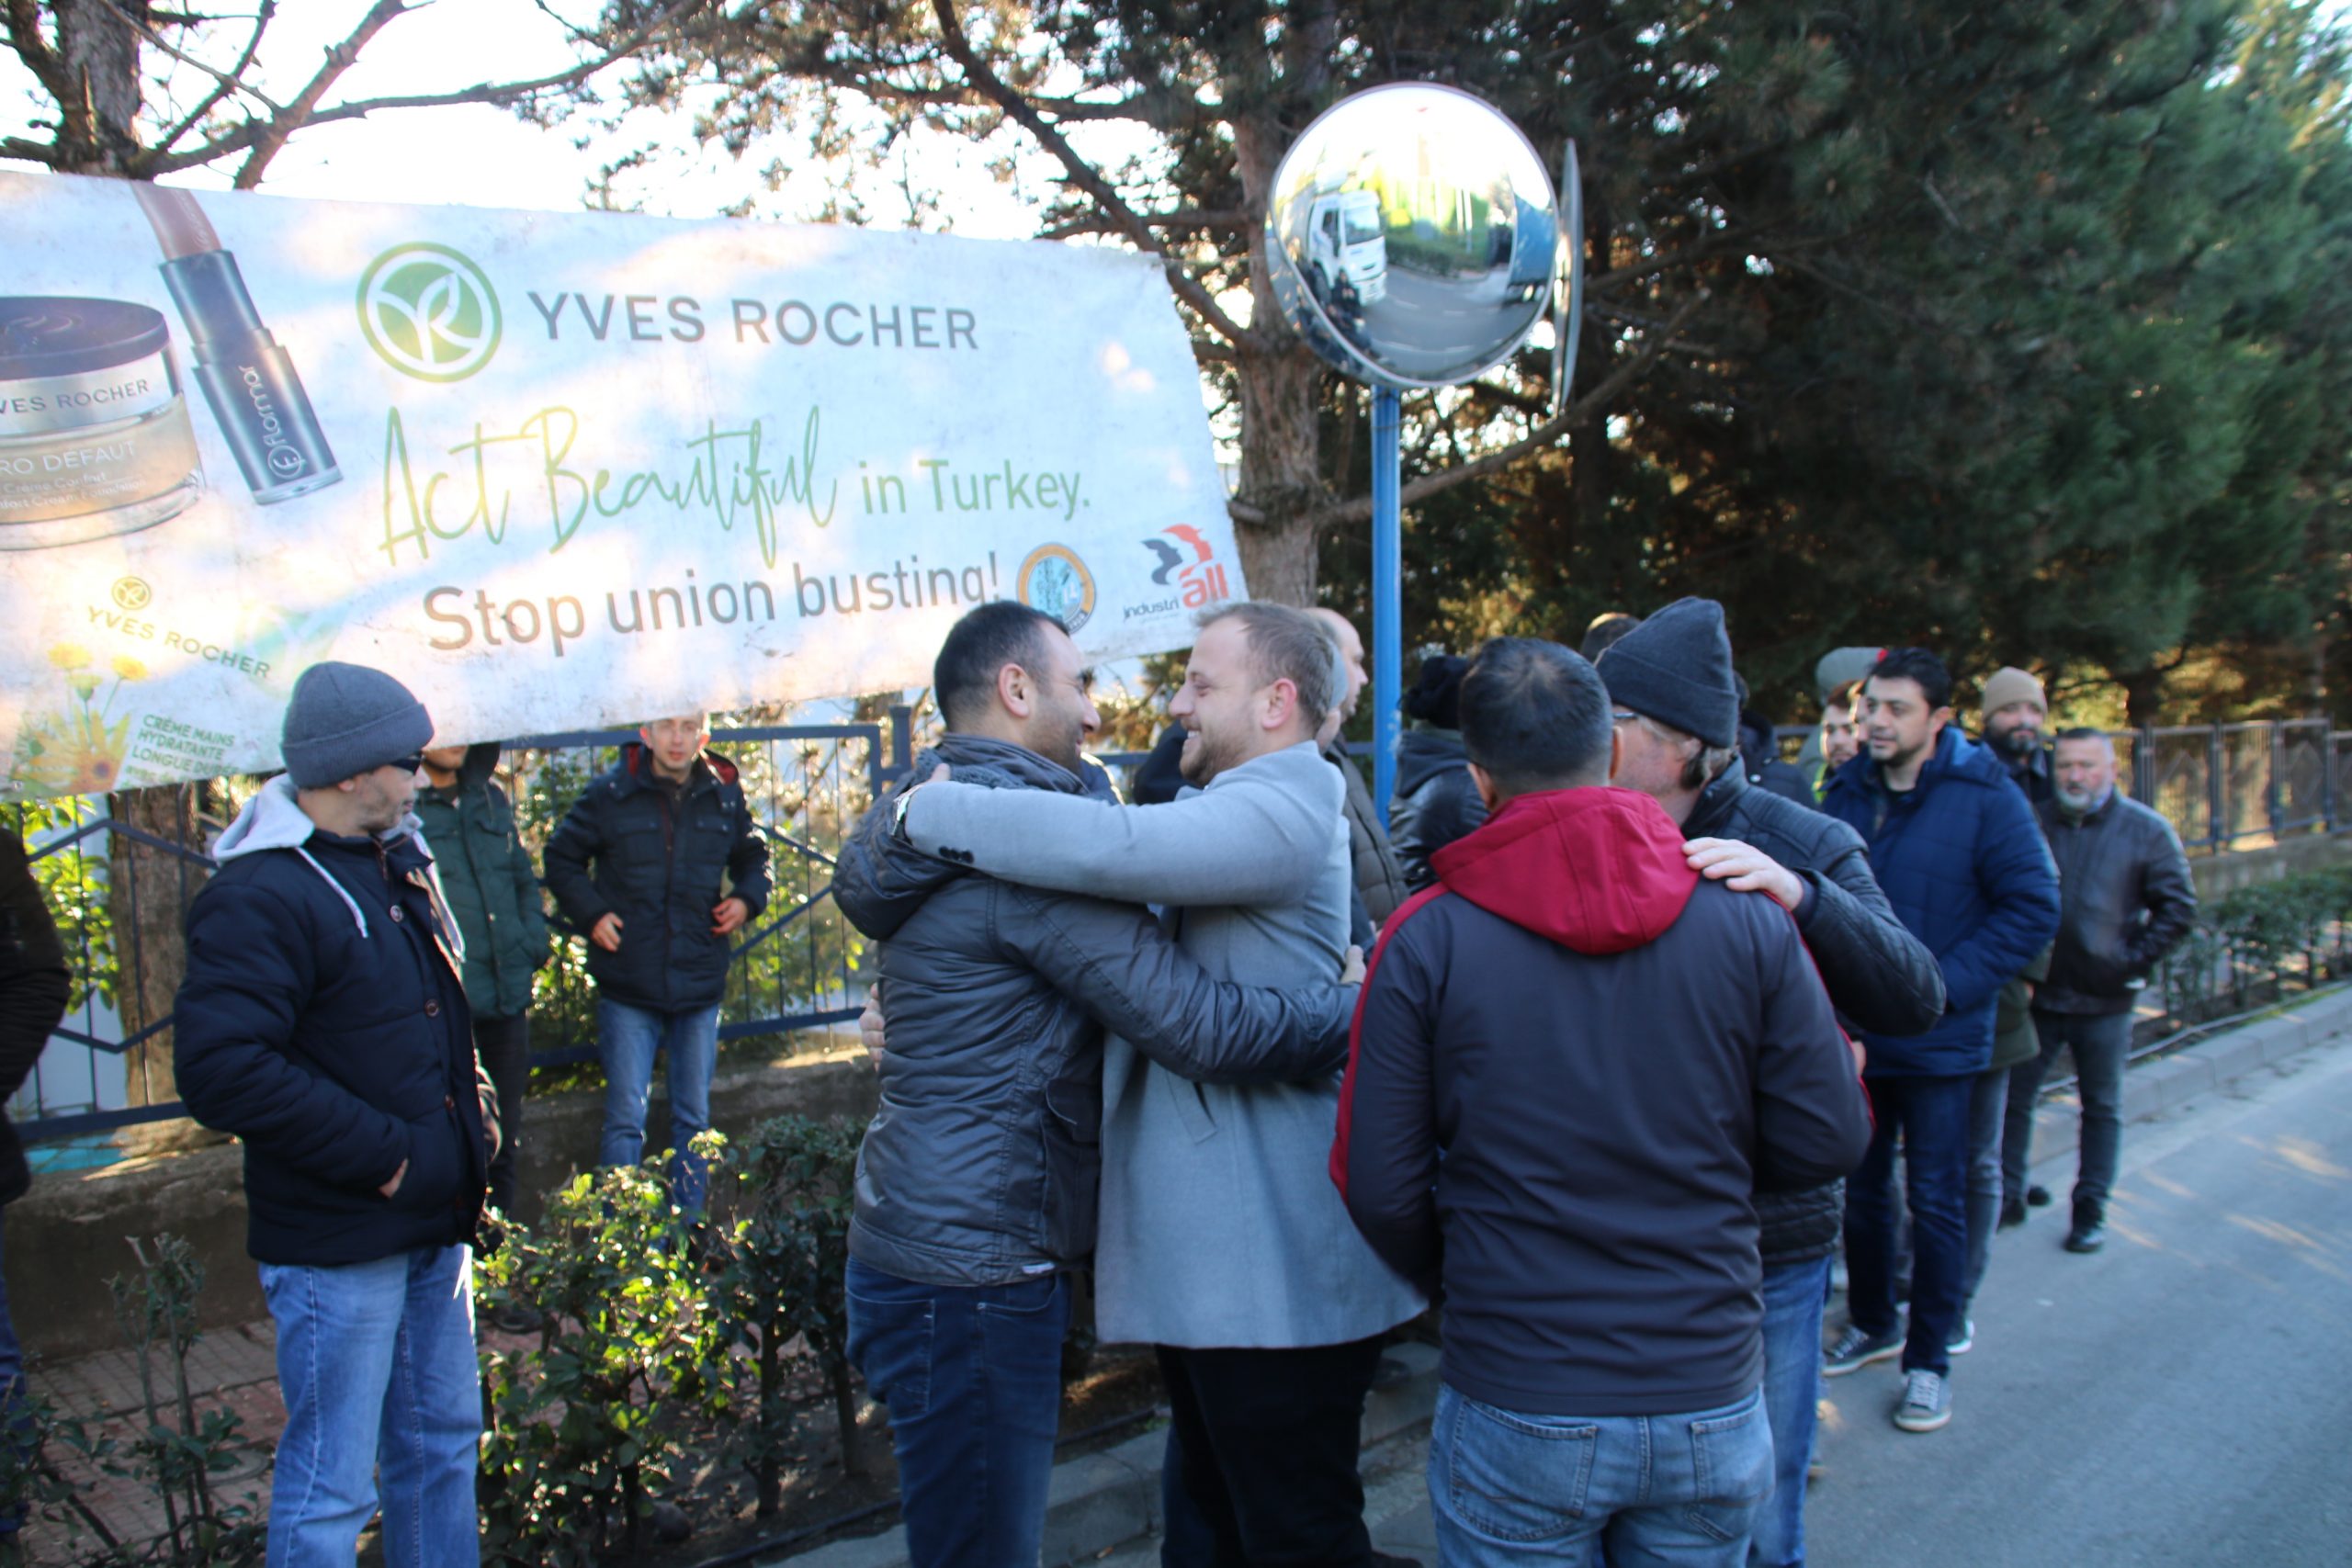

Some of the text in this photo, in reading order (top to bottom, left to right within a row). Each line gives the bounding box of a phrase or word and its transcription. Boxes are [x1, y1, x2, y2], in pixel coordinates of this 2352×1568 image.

[526, 290, 980, 351] YVES ROCHER
[56, 378, 150, 409] ROCHER
[379, 404, 1091, 570] Act Beautiful in Turkey.
[423, 551, 1000, 657] Stop union busting!
[1182, 562, 1229, 608] all
[87, 604, 271, 678] YVES ROCHER
[131, 745, 191, 772] LONGUE
[137, 728, 226, 761] HYDRATANTE
[194, 726, 235, 748] MAINS
